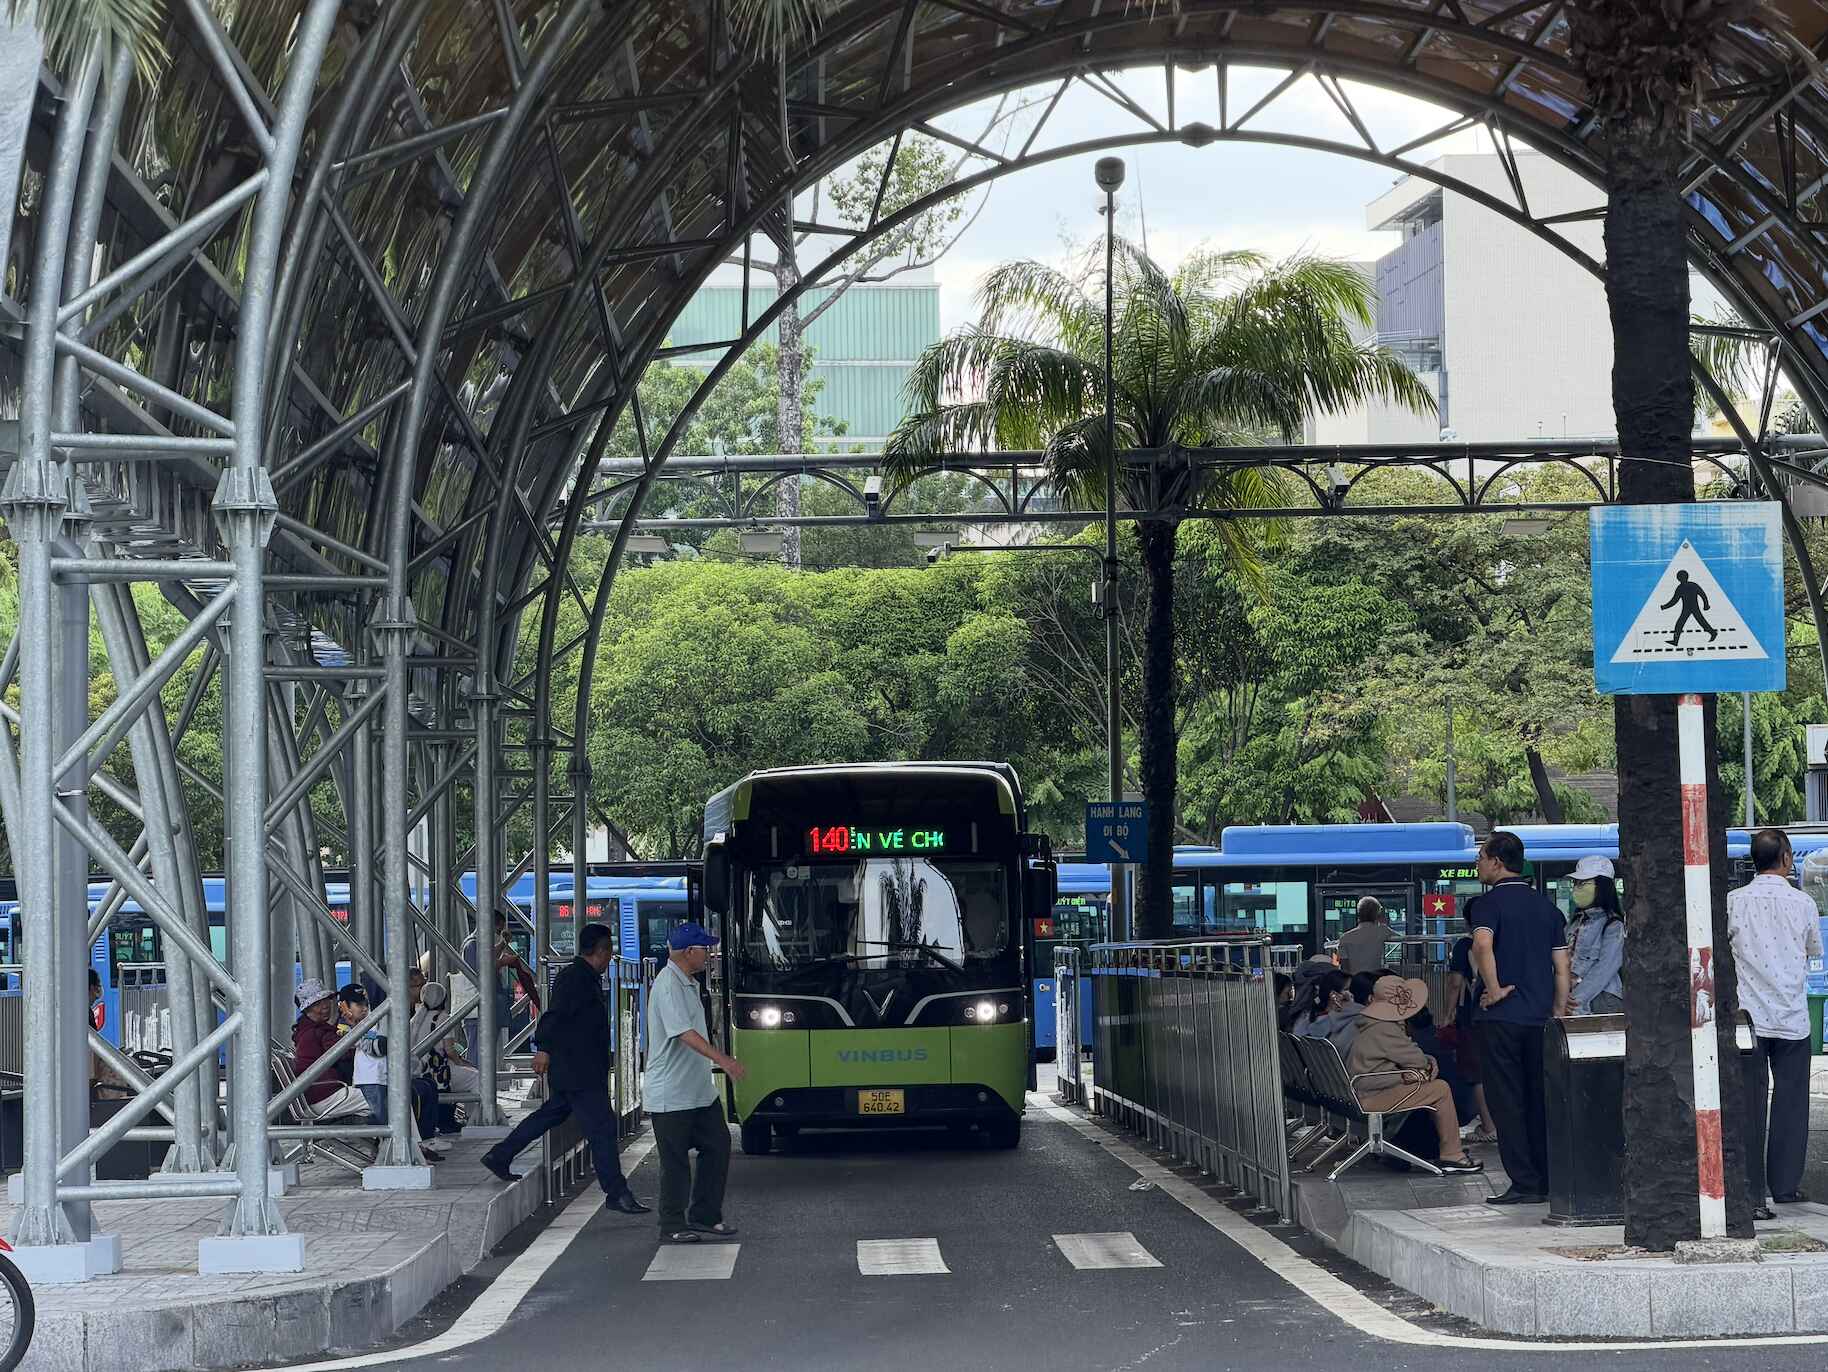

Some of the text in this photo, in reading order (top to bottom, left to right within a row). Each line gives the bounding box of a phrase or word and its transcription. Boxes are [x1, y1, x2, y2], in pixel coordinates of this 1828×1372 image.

[1090, 804, 1143, 819] HÀNH LANG
[1116, 822, 1129, 840] BỘ
[809, 826, 849, 852] 140
[879, 828, 904, 849] VÉ
[1440, 869, 1455, 878] XE
[838, 1048, 928, 1062] VINBUS
[871, 1092, 891, 1102] 50E
[863, 1103, 900, 1113] 640.42
